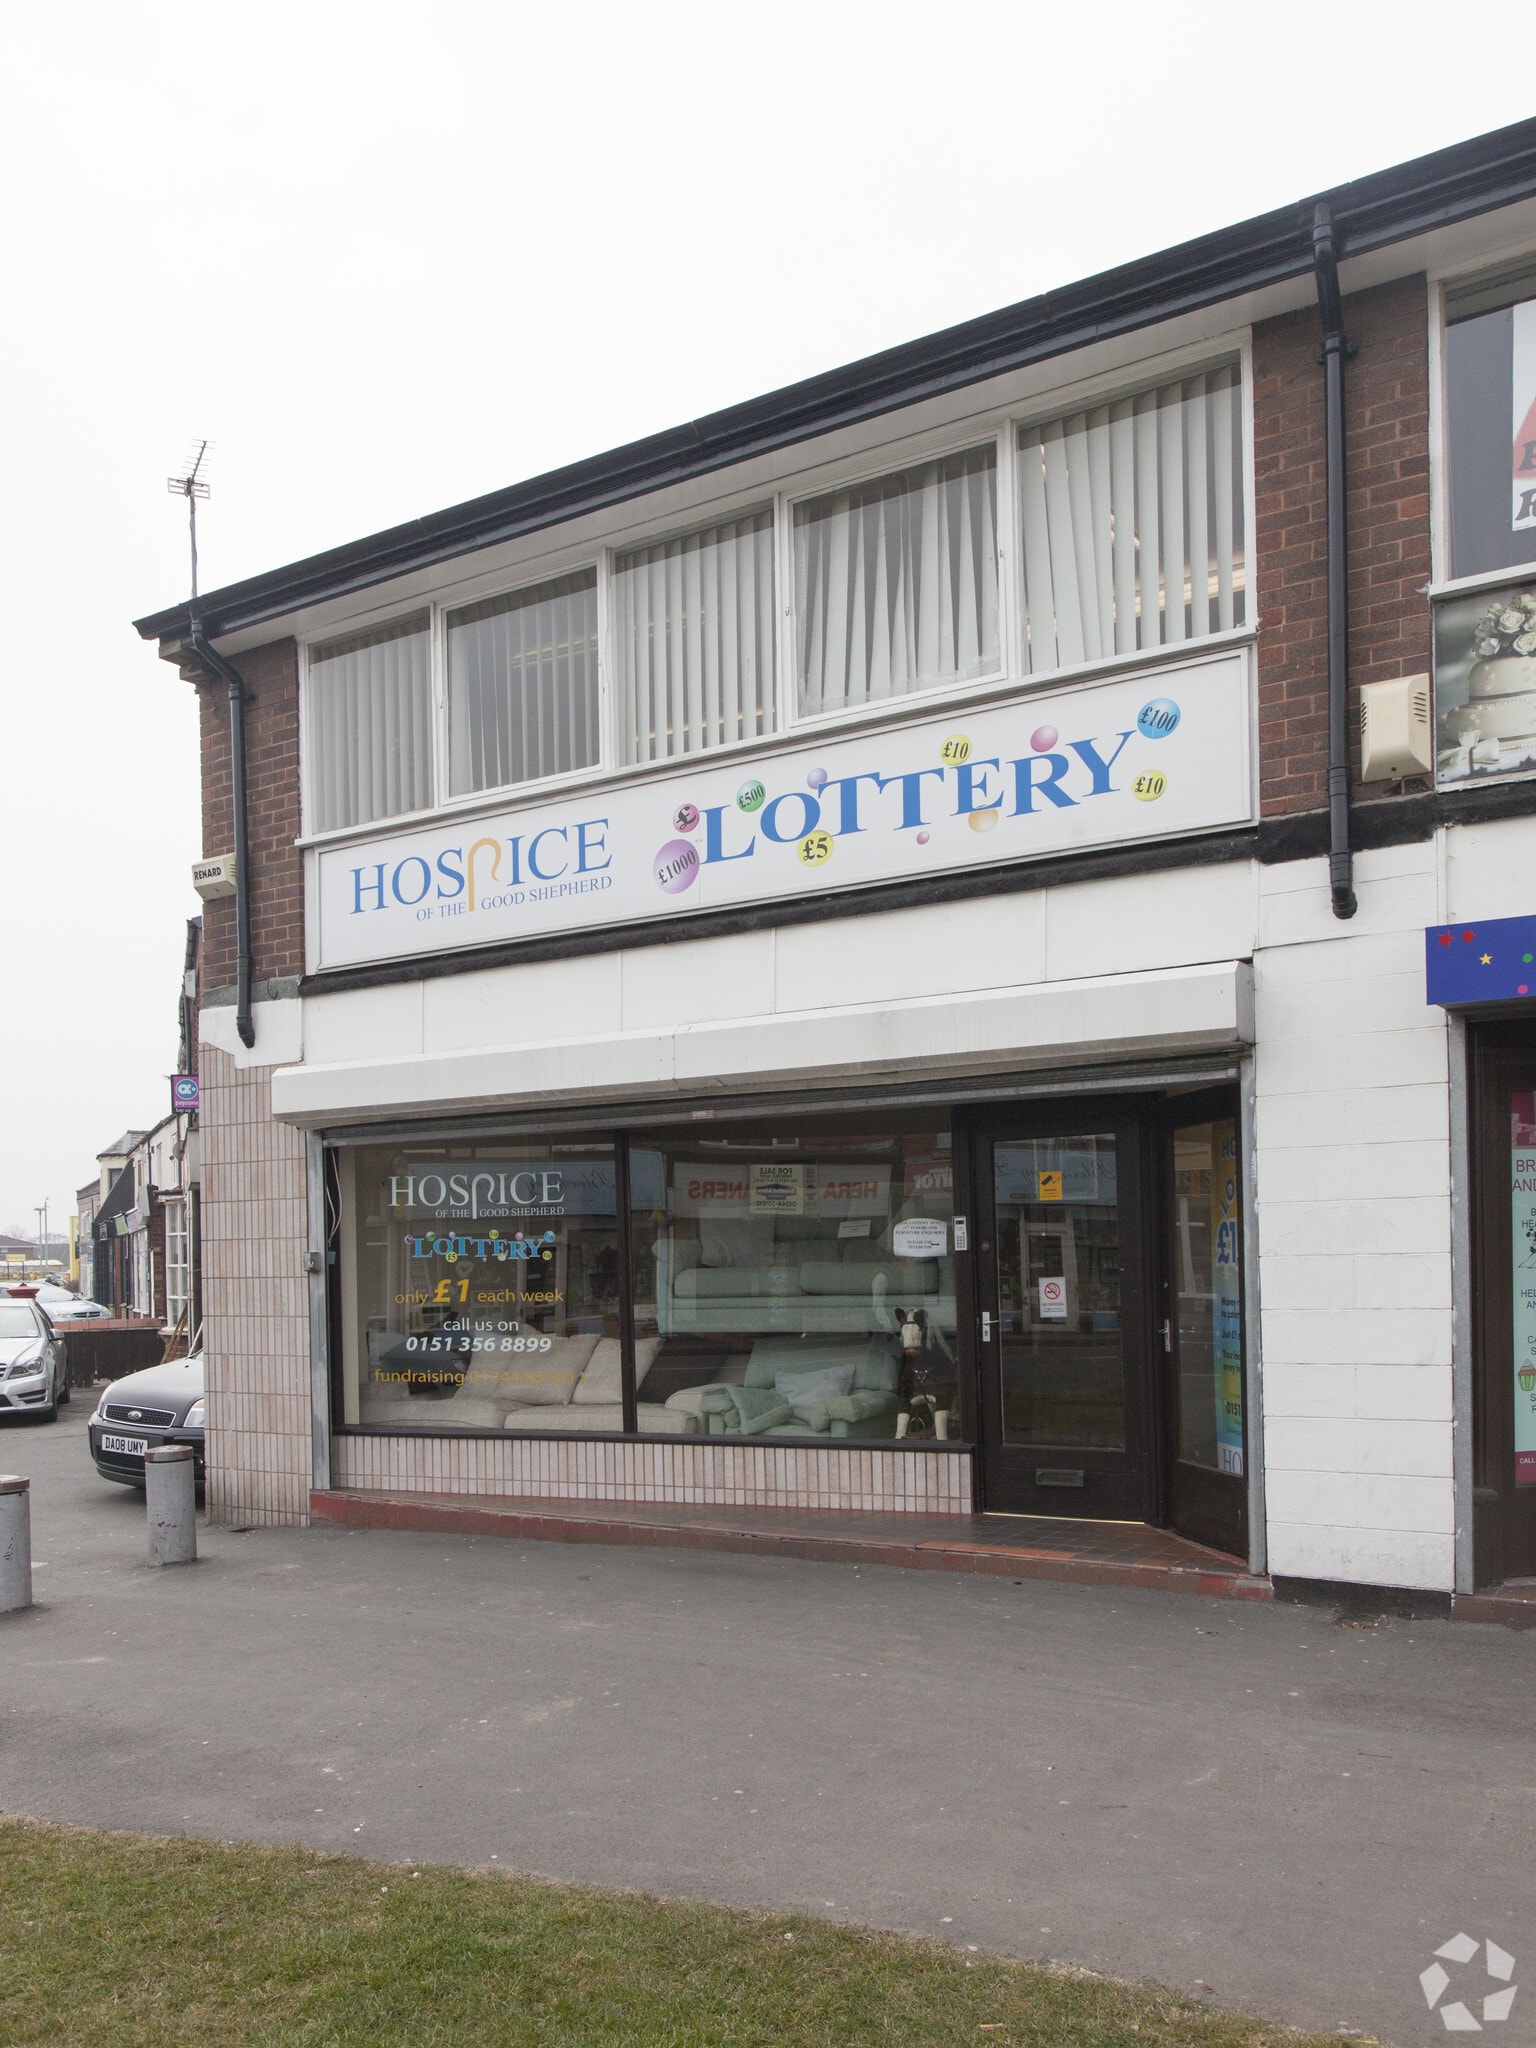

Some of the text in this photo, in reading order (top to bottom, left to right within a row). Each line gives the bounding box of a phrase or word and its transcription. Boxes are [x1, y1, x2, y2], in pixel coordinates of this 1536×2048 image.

[1138, 706, 1177, 731] £100
[942, 742, 969, 759] £10
[1135, 777, 1164, 794] £10
[699, 730, 1137, 865] LOTTERY
[737, 785, 766, 810] £500
[803, 837, 828, 861] £5
[194, 867, 222, 880] RENARD
[349, 818, 613, 914] HOSPICE
[658, 849, 697, 886] £1000
[416, 876, 612, 922] OF THE GOOD SHEPHERD
[388, 1171, 565, 1219] HOSPICE
[435, 1206, 565, 1218] OF THE GOOD SHEPHERD
[413, 1236, 545, 1260] LOTTERY
[447, 1253, 456, 1261] £5
[395, 1279, 564, 1305] only £1 each week
[443, 1318, 519, 1331] call us on
[406, 1337, 552, 1352] 0151 356 8899
[375, 1369, 585, 1386] fundraising 01244 851811
[1226, 1402, 1241, 1416] 0151
[105, 1437, 144, 1453] DA08 UMY
[1519, 1457, 1536, 1465] CALL
